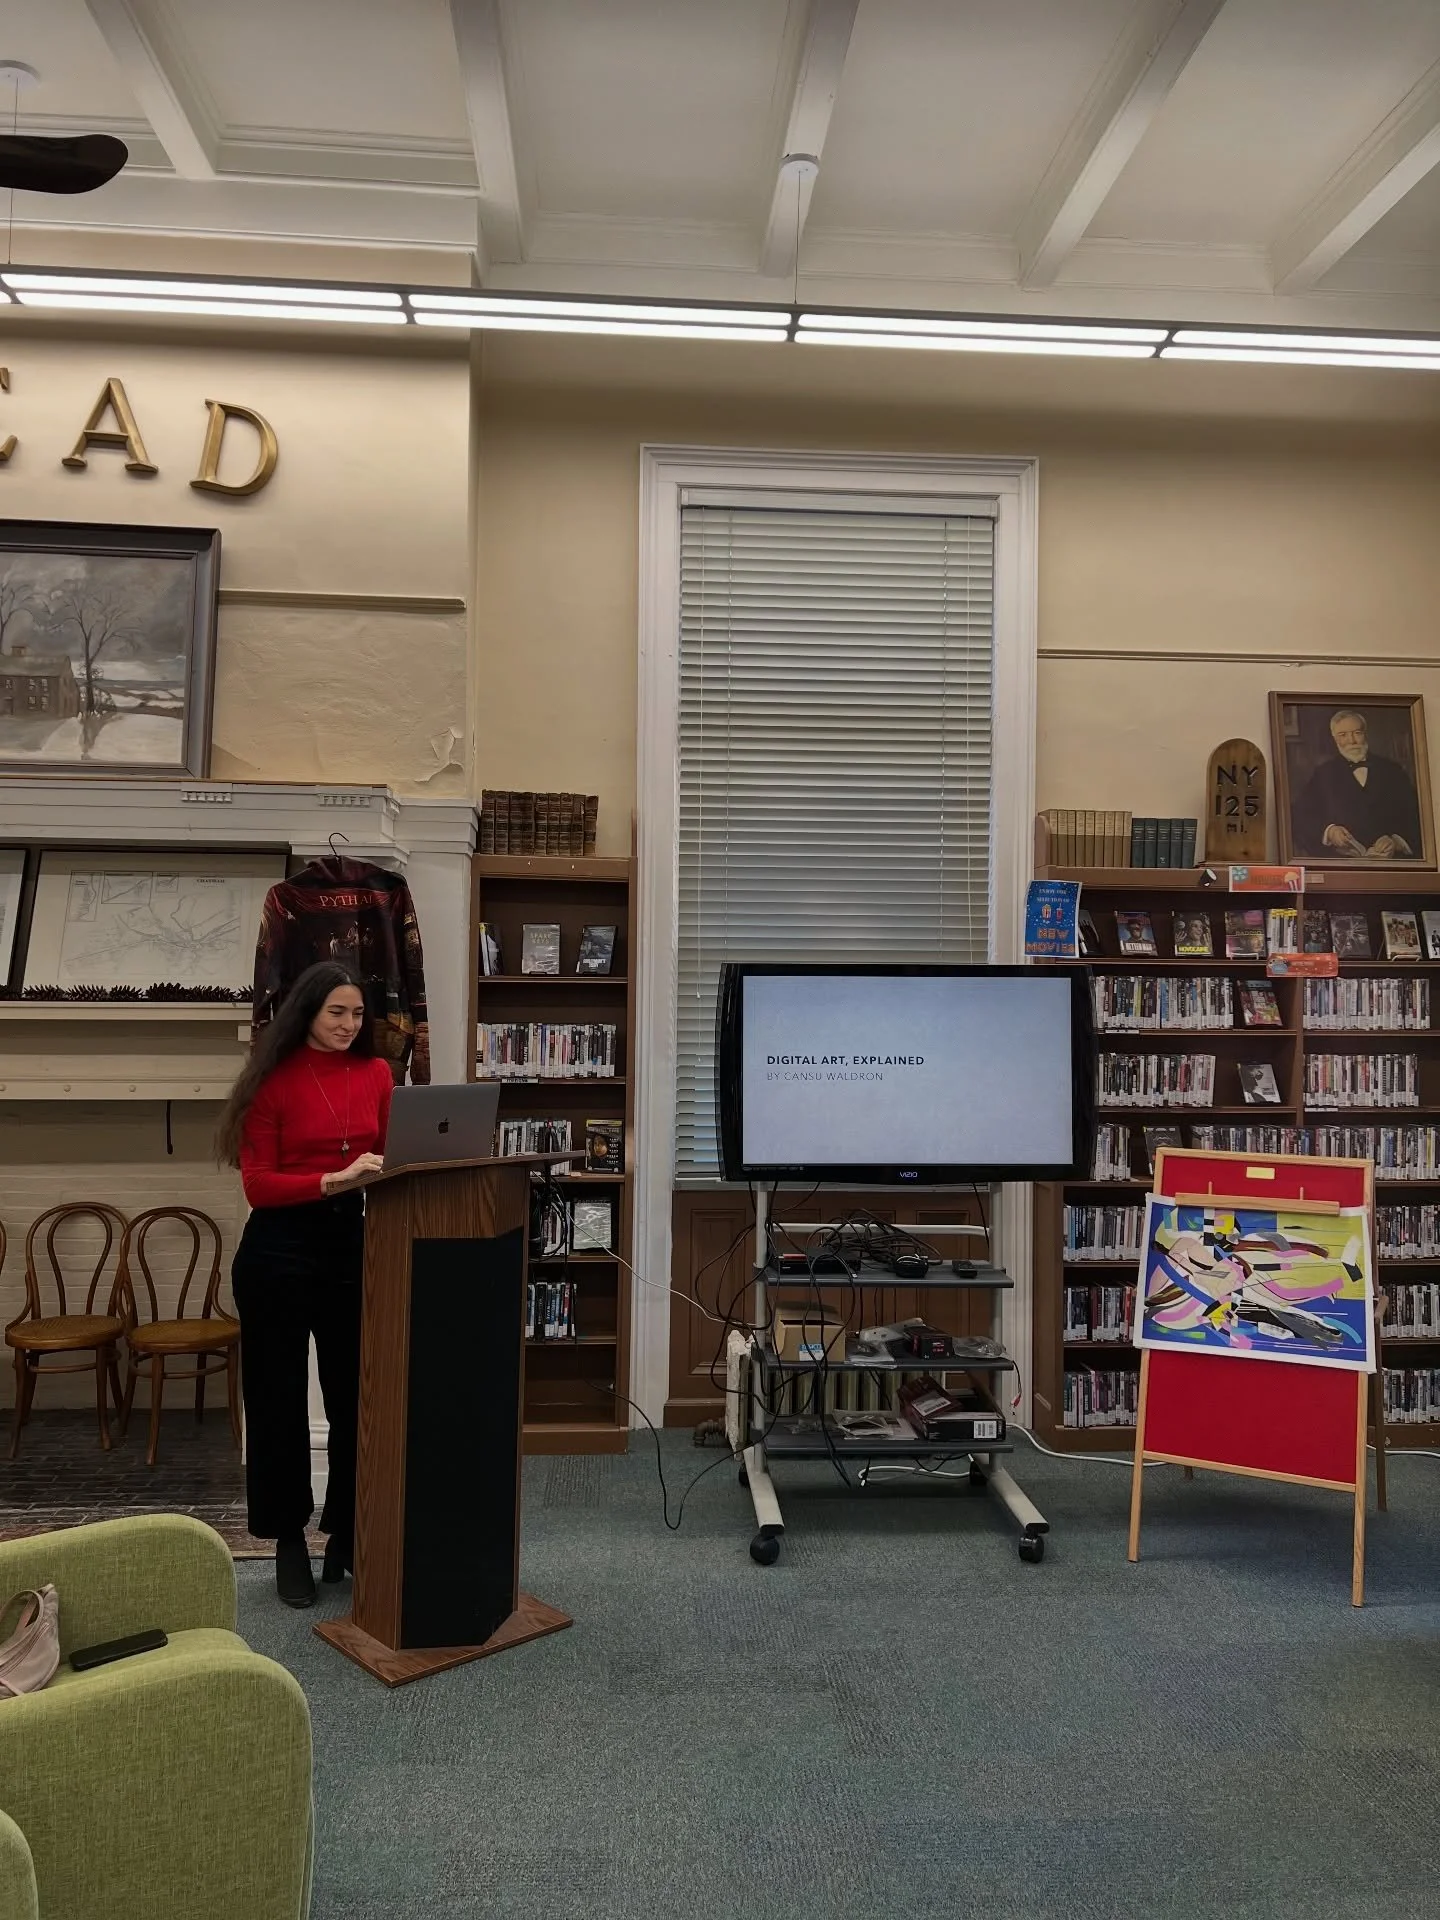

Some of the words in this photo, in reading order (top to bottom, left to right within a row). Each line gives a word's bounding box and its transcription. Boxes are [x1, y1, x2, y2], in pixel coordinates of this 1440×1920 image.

[1216, 763, 1258, 788] NY
[1215, 794, 1260, 817] 125
[1037, 927, 1070, 940] NEW
[1025, 941, 1075, 954] MOVIES
[767, 1055, 817, 1065] DIGITAL
[821, 1055, 848, 1067] ART,
[853, 1055, 925, 1066] EXPLAINED
[767, 1072, 780, 1081] BY
[784, 1072, 822, 1081] CANSU
[826, 1072, 884, 1081] WALDRON
